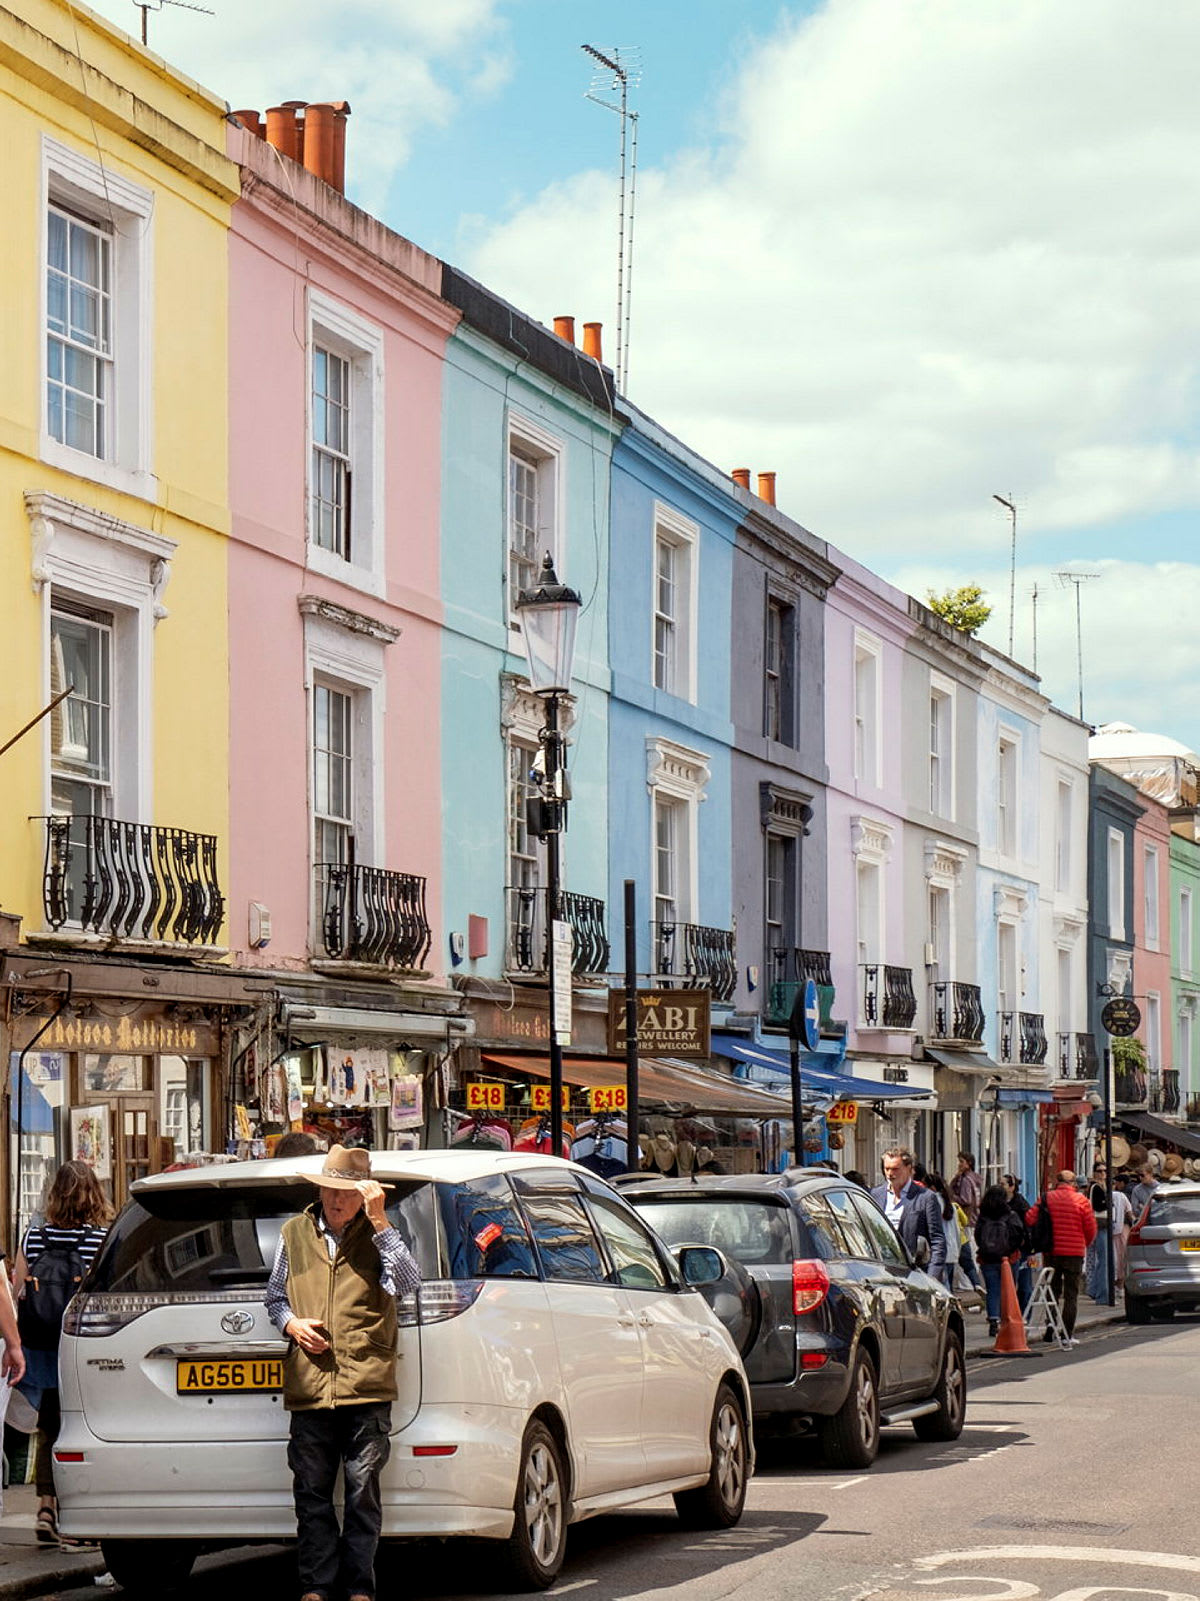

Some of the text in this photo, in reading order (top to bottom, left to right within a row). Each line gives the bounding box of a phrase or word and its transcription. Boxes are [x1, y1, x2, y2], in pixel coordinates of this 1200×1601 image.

[636, 1031, 696, 1040] EWELLERY
[616, 1041, 701, 1050] REIRS WELCOME
[471, 1087, 501, 1105] £18
[594, 1089, 626, 1108] £18
[829, 1104, 856, 1119] £18
[186, 1363, 281, 1387] AG56 UH
